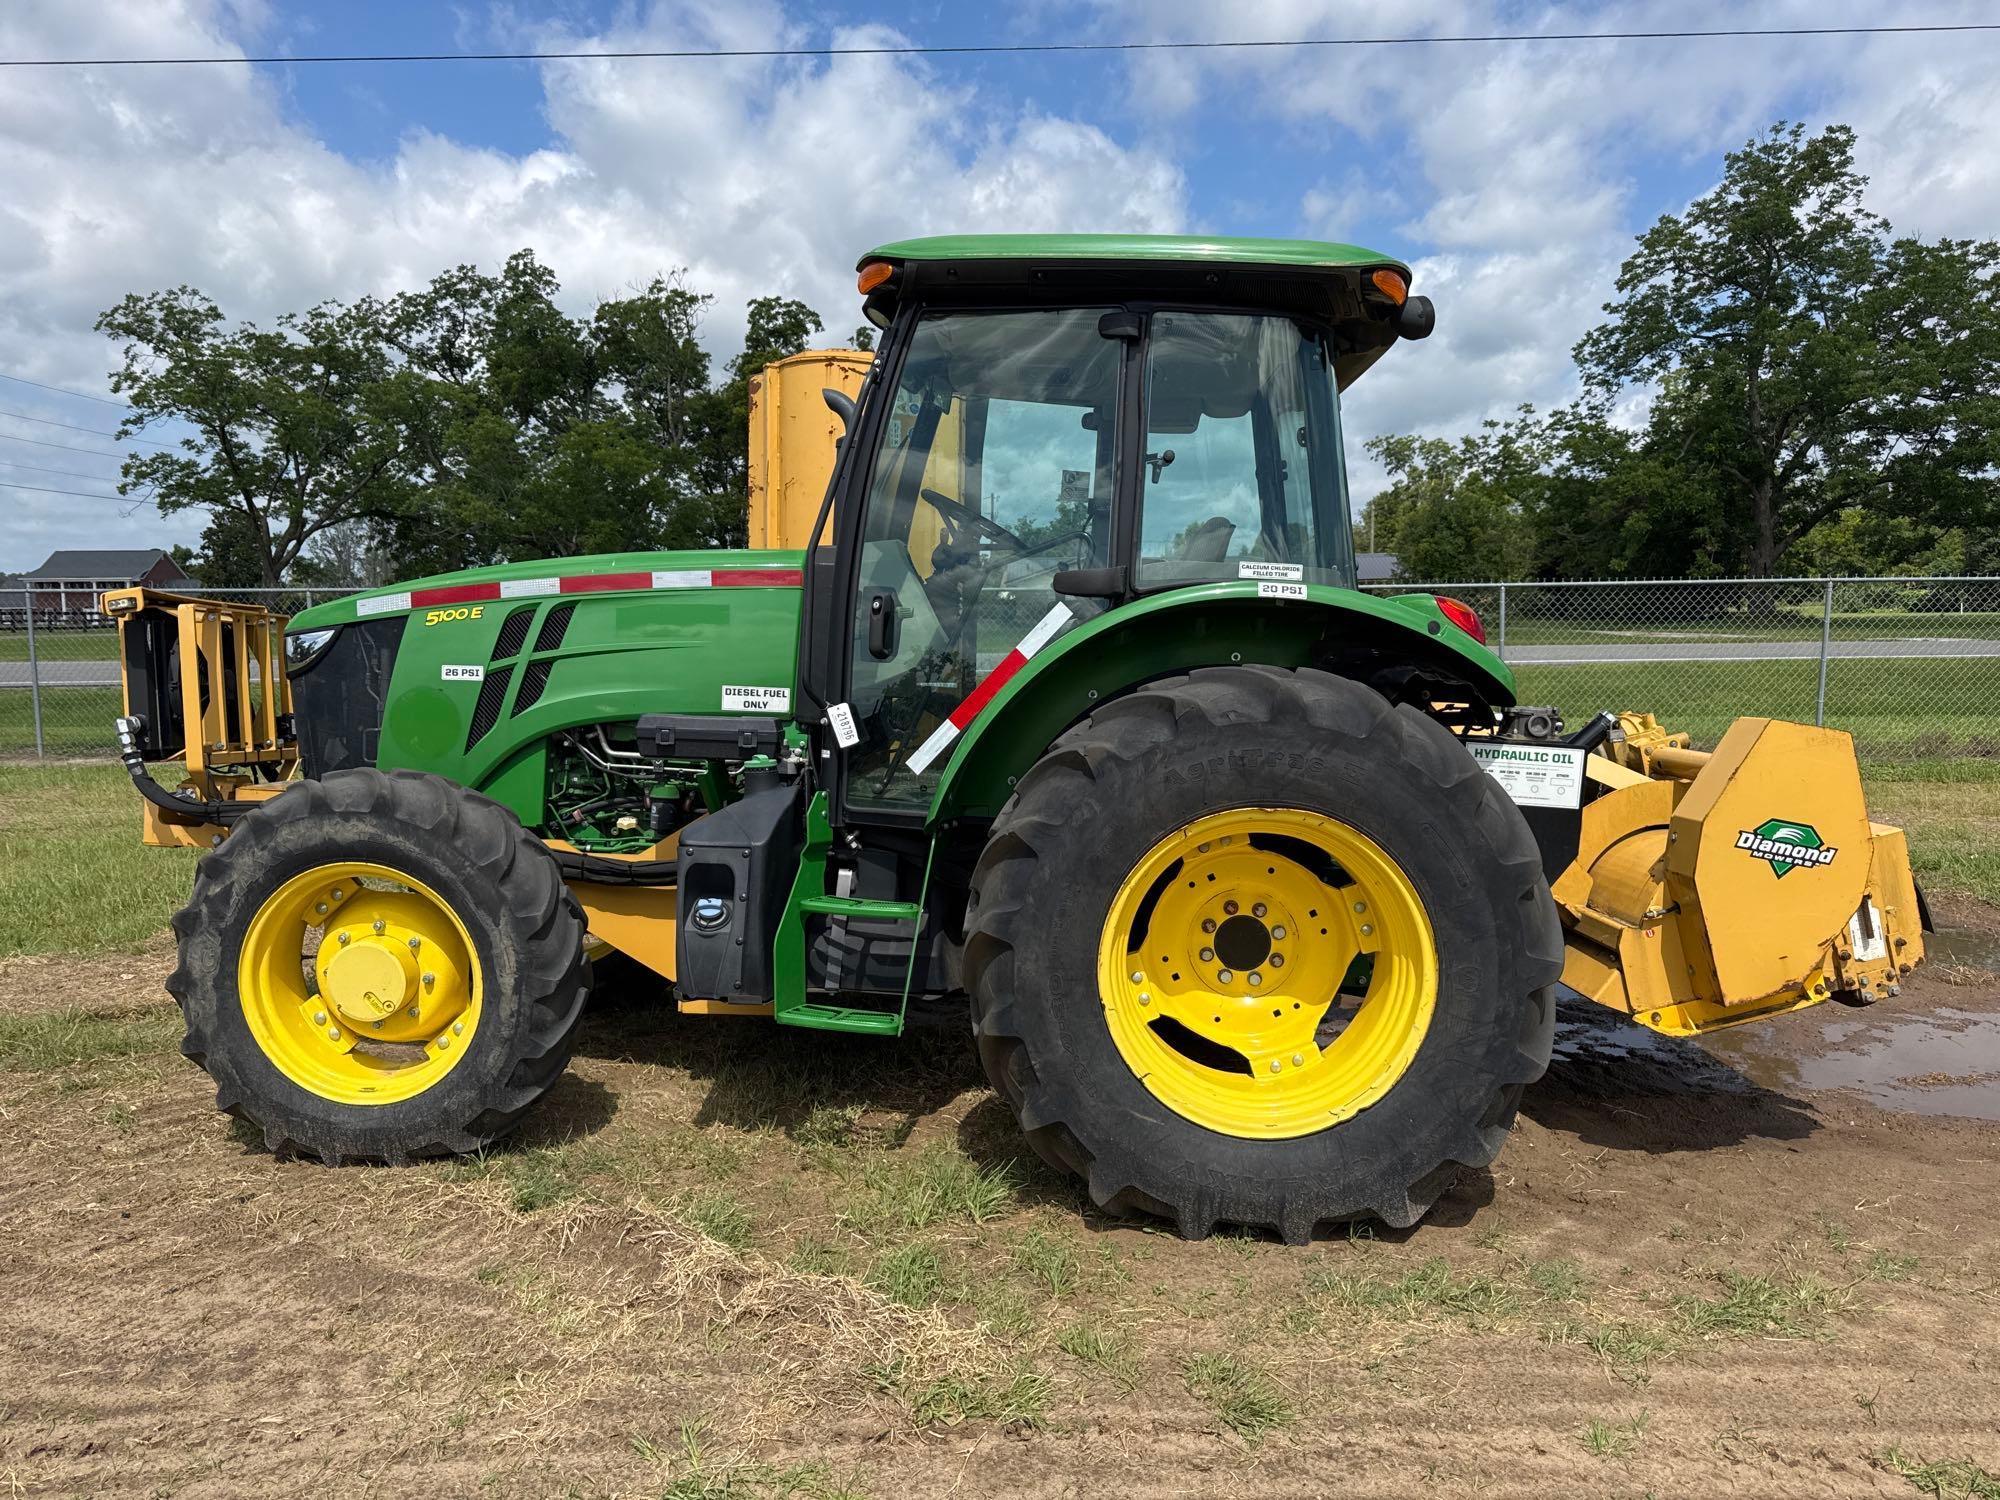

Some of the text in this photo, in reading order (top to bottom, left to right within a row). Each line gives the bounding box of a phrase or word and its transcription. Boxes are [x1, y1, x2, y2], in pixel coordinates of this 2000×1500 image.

[1271, 565, 1300, 573] CHLORIDE
[1262, 584, 1303, 595] 20 PSI
[425, 606, 484, 626] 5100 E
[445, 668, 480, 677] 26 PSI
[725, 688, 788, 698] DIESEL FUEL
[743, 700, 769, 709] ONLY
[836, 711, 855, 741] 218796
[1474, 748, 1574, 764] HYDRAULIC OIL
[1736, 832, 1837, 864] Diamond
